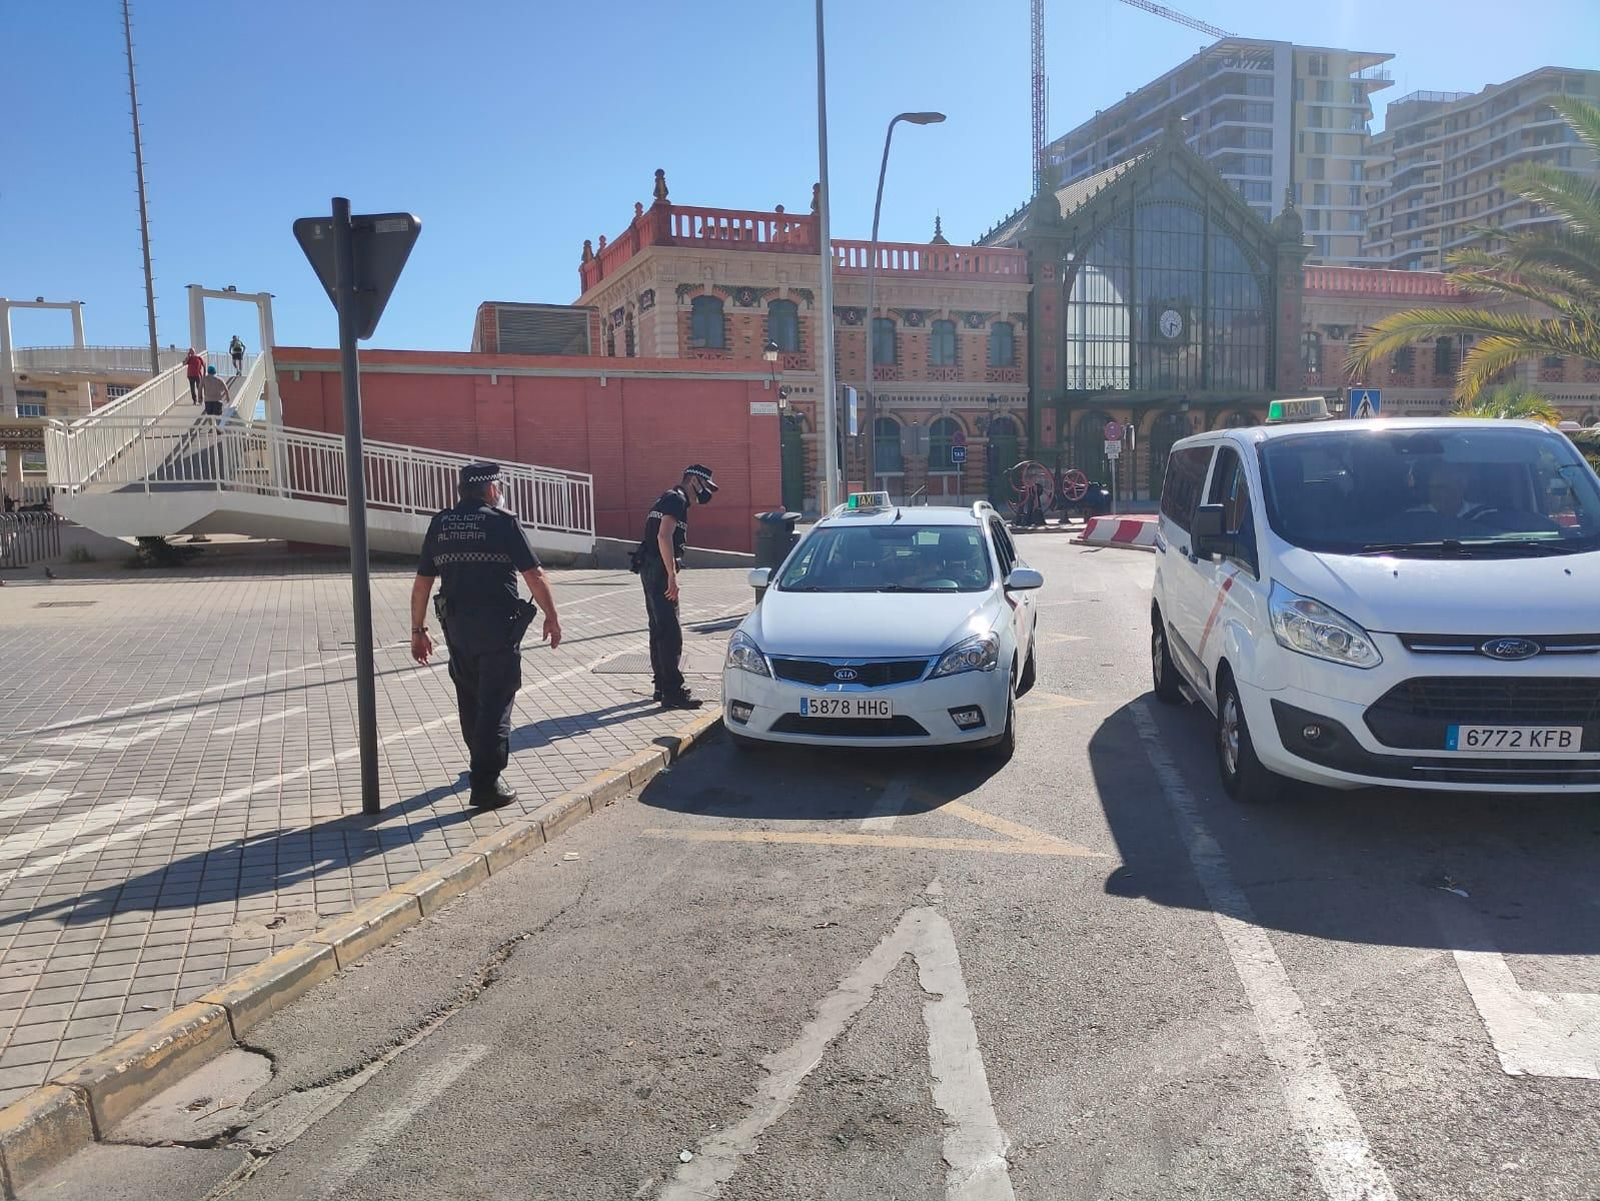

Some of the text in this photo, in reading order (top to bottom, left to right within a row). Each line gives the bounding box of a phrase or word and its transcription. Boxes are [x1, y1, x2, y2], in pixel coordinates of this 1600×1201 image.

[1284, 400, 1309, 417] TAXI
[857, 495, 875, 506] TAXI
[441, 513, 486, 522] POLICIA
[442, 522, 480, 531] LOCAL
[437, 531, 487, 542] ALMERIA
[1495, 640, 1528, 654] Ford
[809, 699, 889, 716] 5878 HHG
[1467, 729, 1523, 747] 6772
[1529, 730, 1573, 748] KFB
